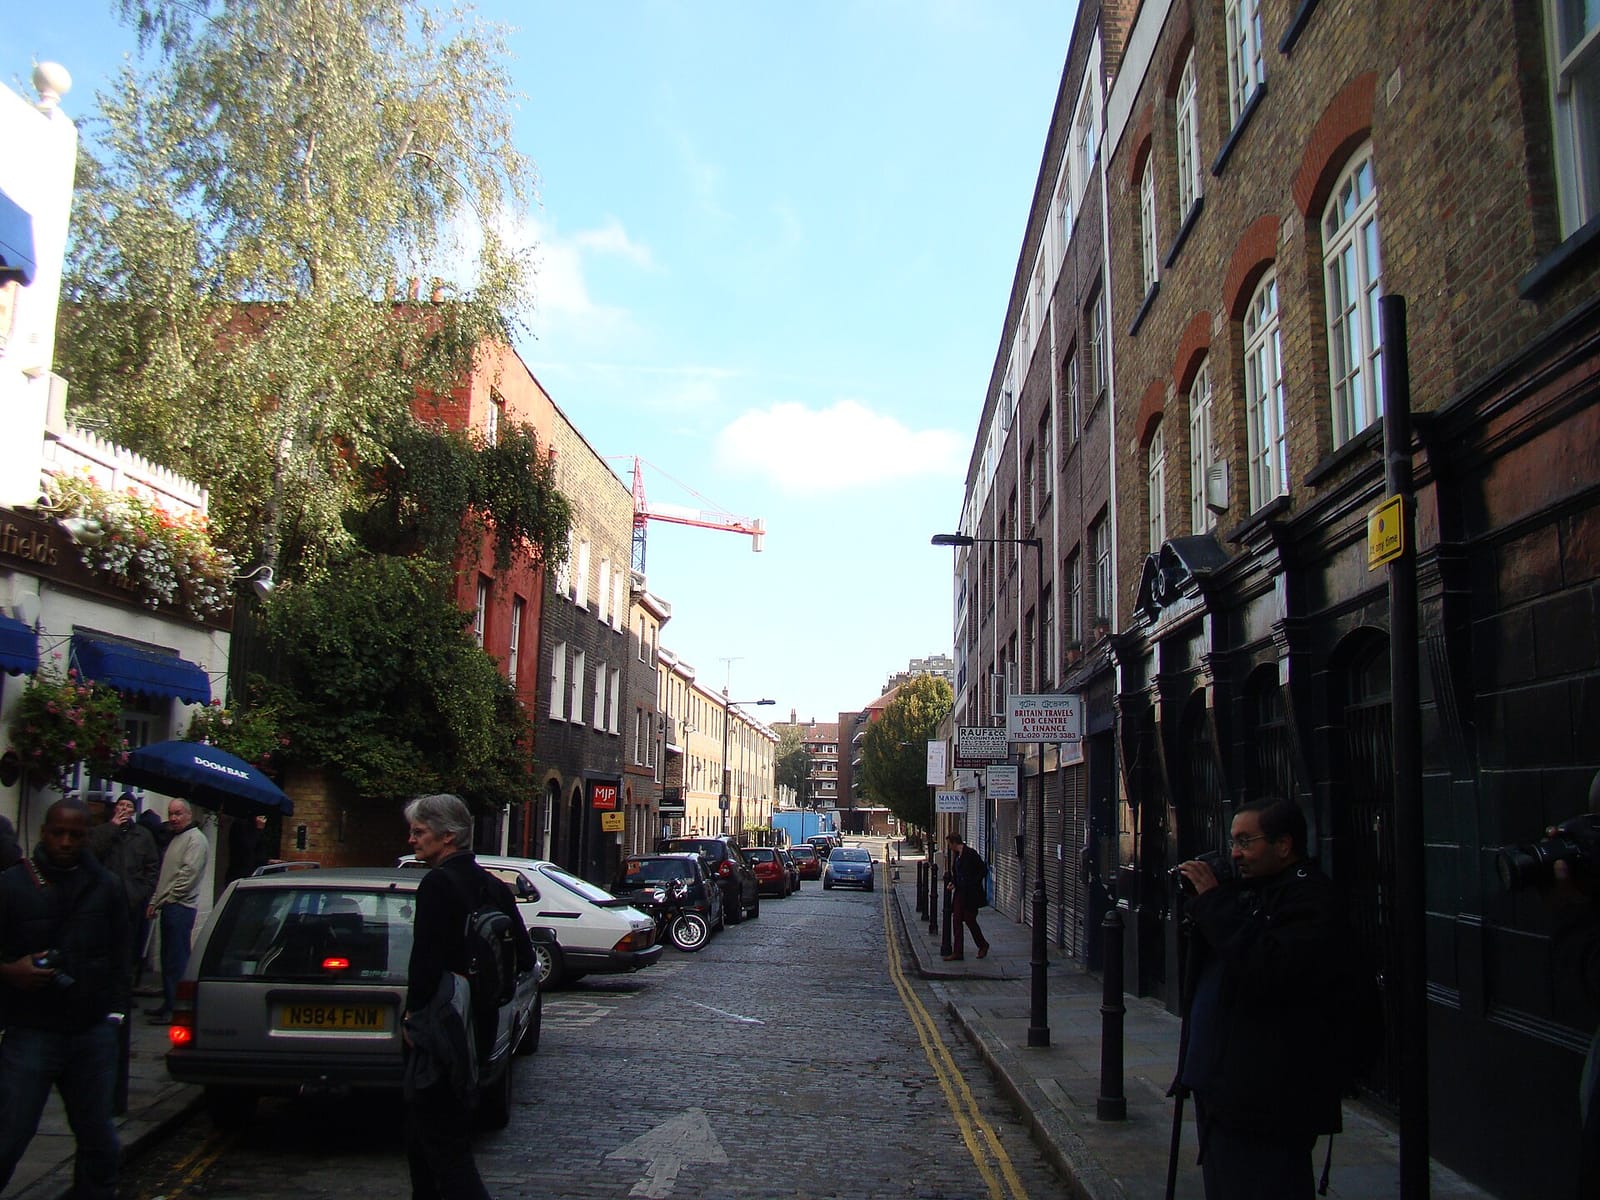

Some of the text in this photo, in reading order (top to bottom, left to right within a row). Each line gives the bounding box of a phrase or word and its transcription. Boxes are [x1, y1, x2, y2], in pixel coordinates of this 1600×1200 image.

[0, 521, 58, 566] fields
[1386, 535, 1398, 547] time
[1014, 709, 1074, 717] BRITAIN TRAVELS
[1021, 717, 1036, 725] JOB
[194, 756, 250, 780] DOOM BAR
[595, 788, 615, 802] MJP
[291, 1007, 379, 1025] N984 FNW
